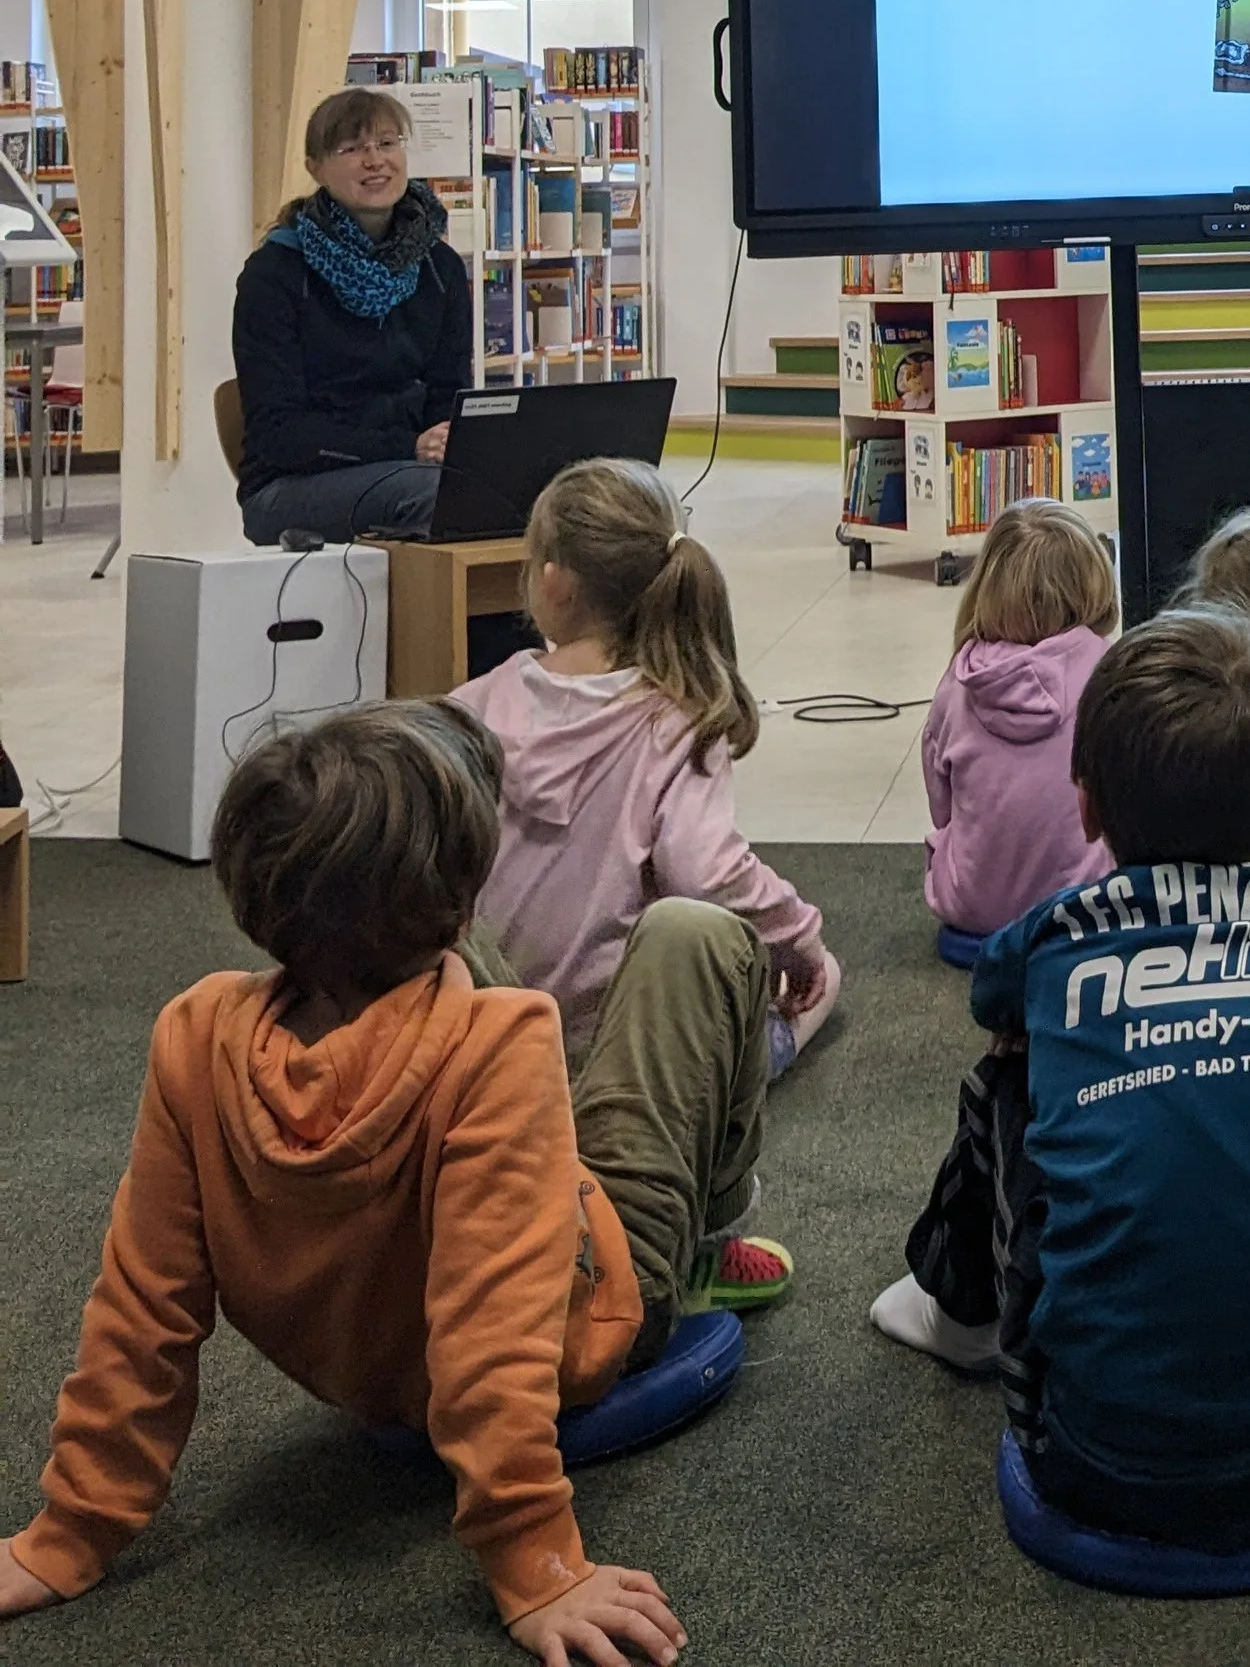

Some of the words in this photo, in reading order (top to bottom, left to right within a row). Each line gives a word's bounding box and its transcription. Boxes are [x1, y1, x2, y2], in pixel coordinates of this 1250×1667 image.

[1079, 875, 1147, 934] FC
[1076, 1064, 1176, 1107] GERETSRIED
[1195, 1058, 1236, 1077] BAD
